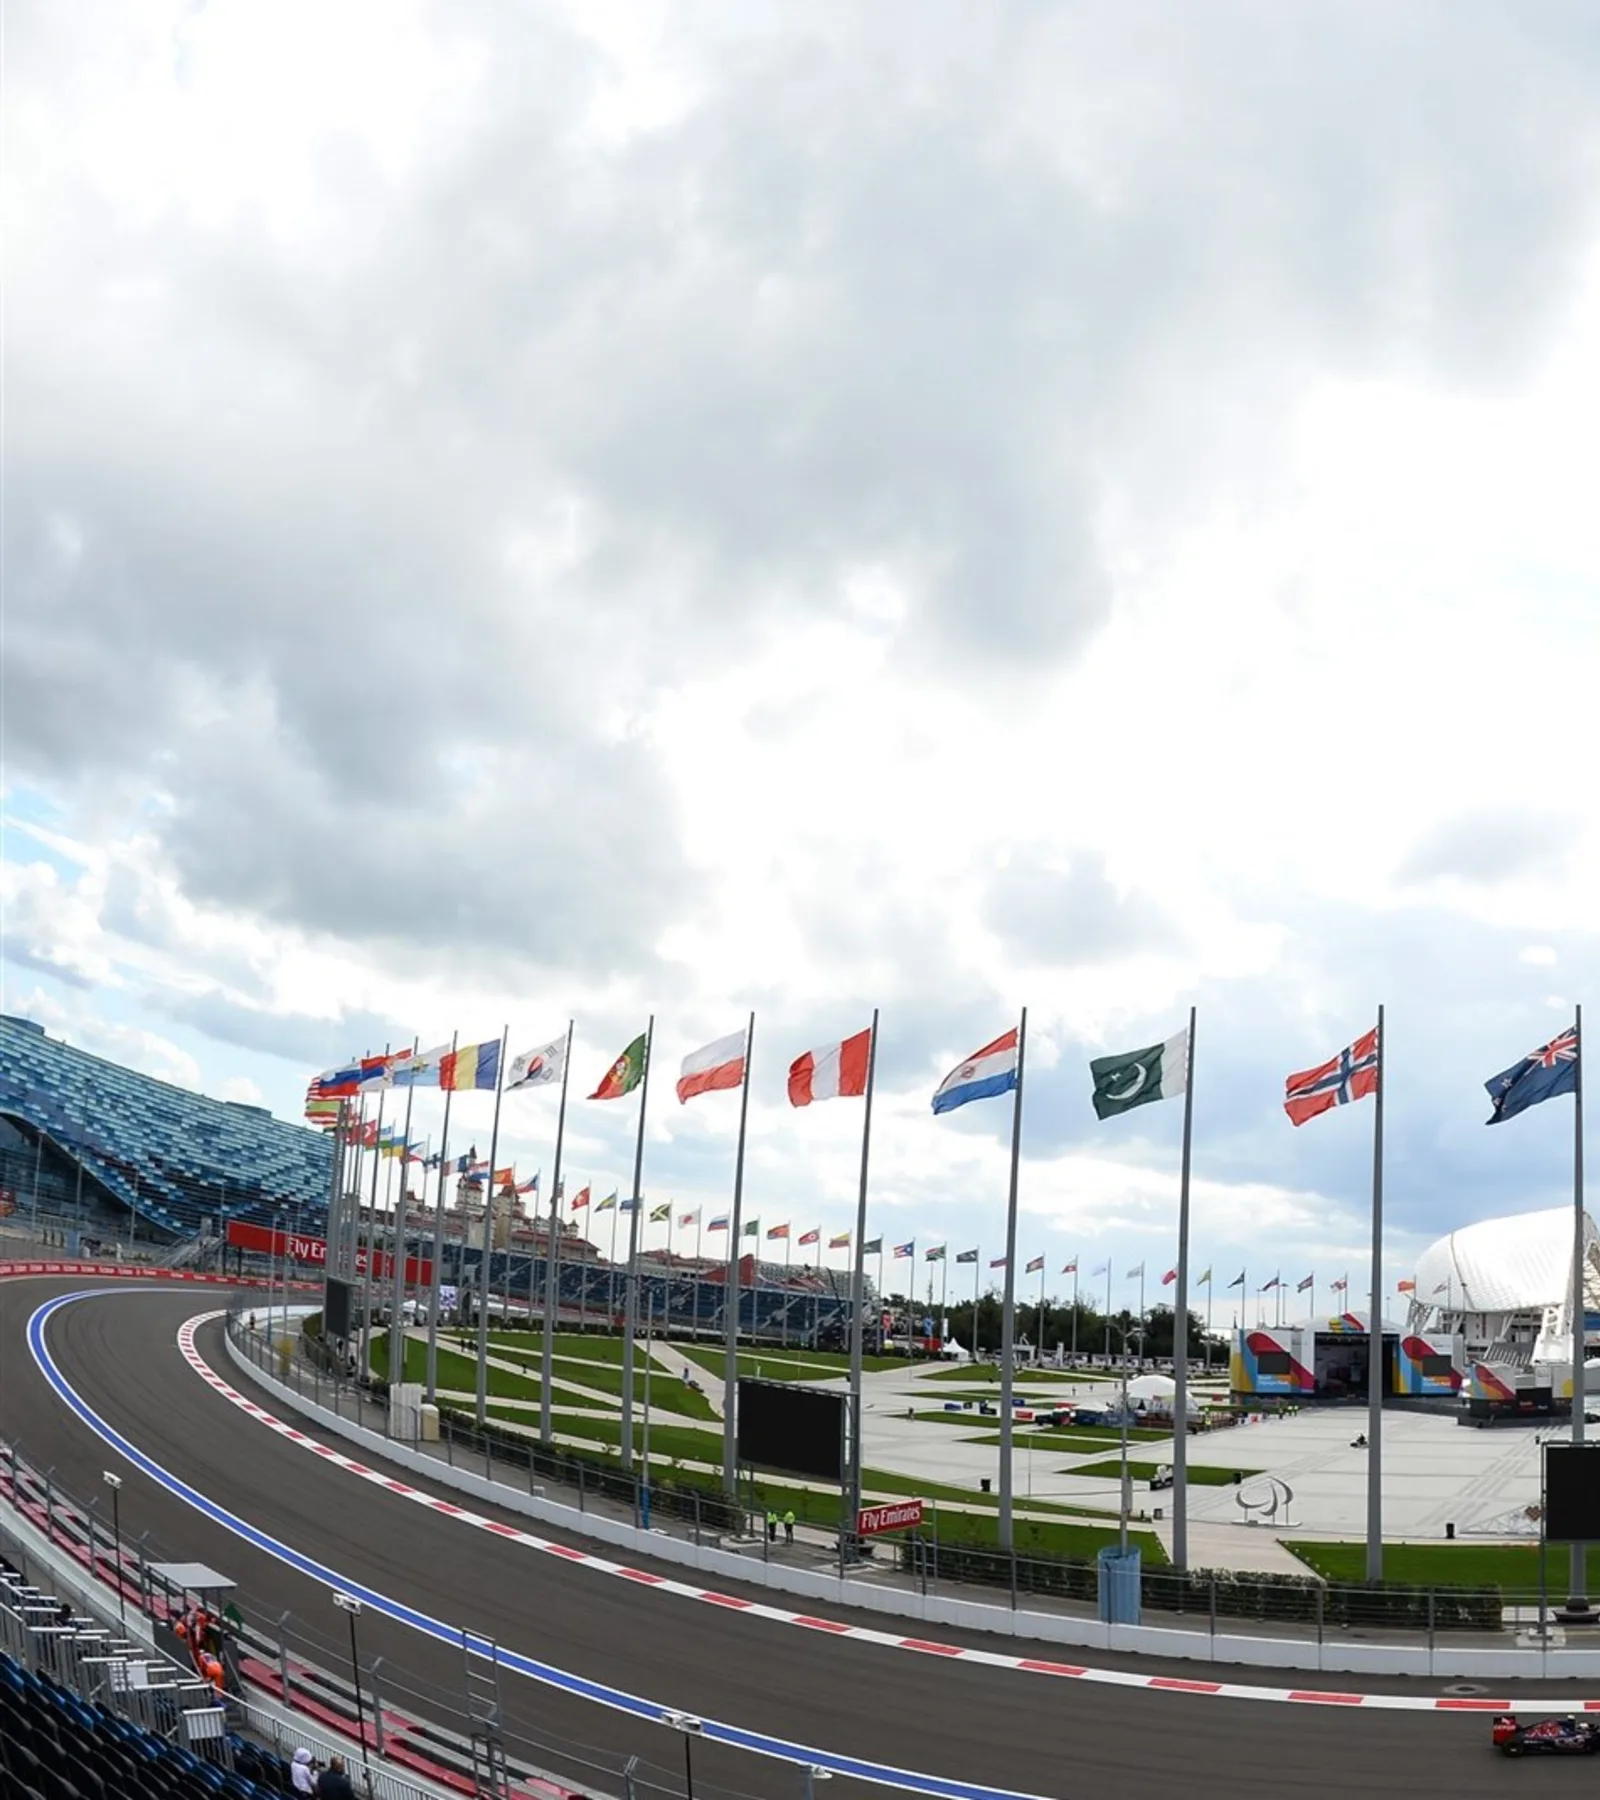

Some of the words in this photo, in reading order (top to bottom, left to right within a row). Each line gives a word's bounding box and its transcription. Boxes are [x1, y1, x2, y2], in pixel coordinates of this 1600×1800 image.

[287, 1237, 310, 1259] Fly
[862, 1511, 880, 1530] Fly
[880, 1506, 920, 1526] Emirates
